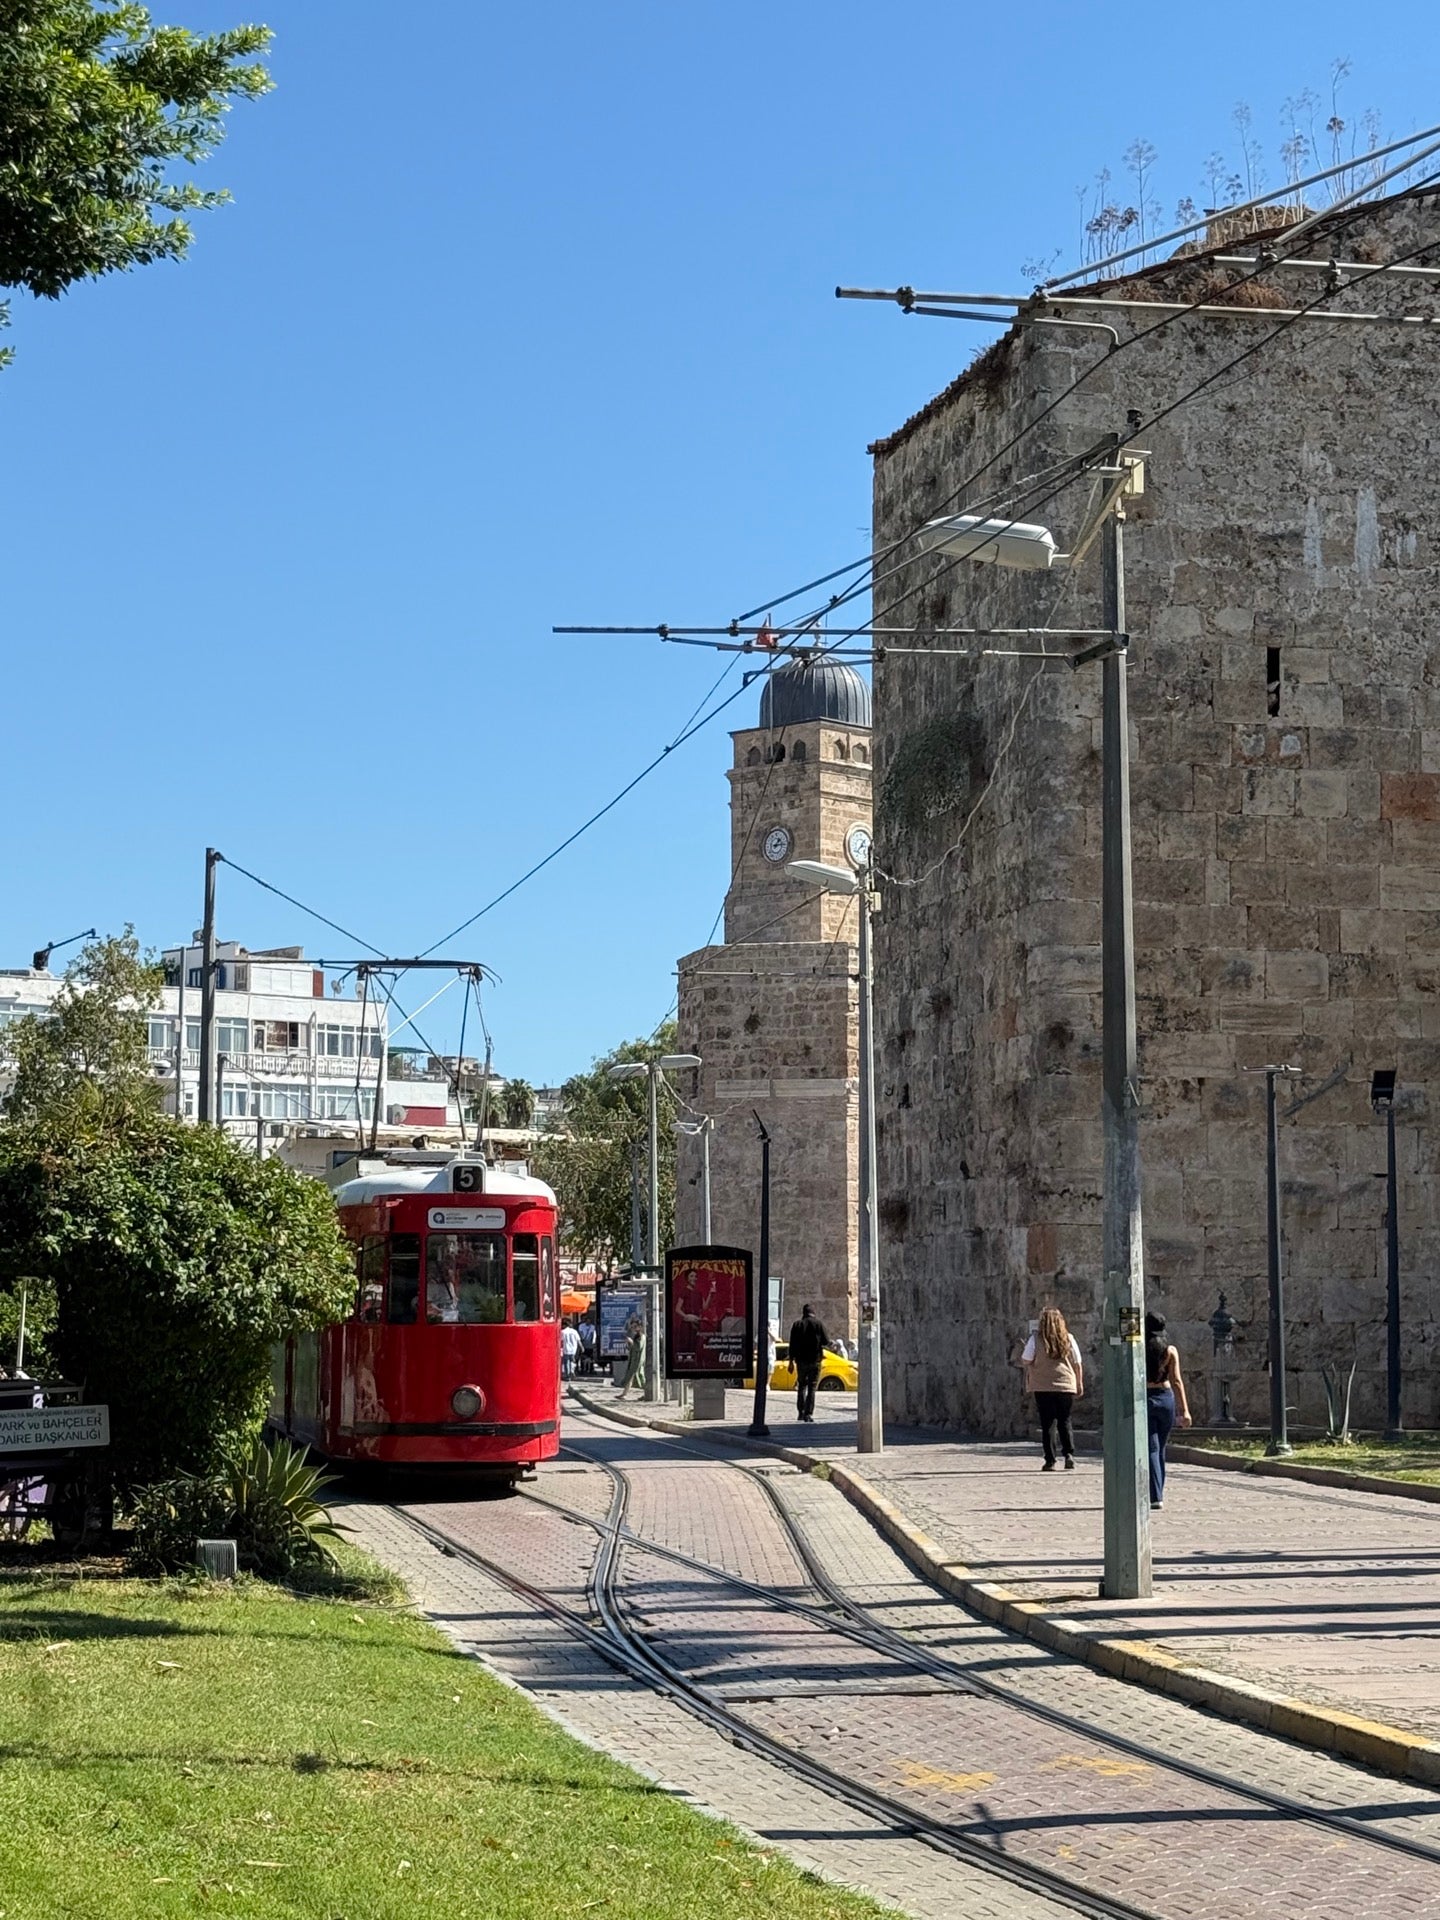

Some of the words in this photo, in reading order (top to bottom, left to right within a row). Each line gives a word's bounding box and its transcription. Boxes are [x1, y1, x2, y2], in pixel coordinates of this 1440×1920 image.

[460, 1167, 474, 1188] 5
[719, 1351, 743, 1367] letgo
[0, 1421, 26, 1431] ARK
[43, 1416, 103, 1430] BAHÇELER
[35, 1429, 101, 1444] BAŞKANLIĞI
